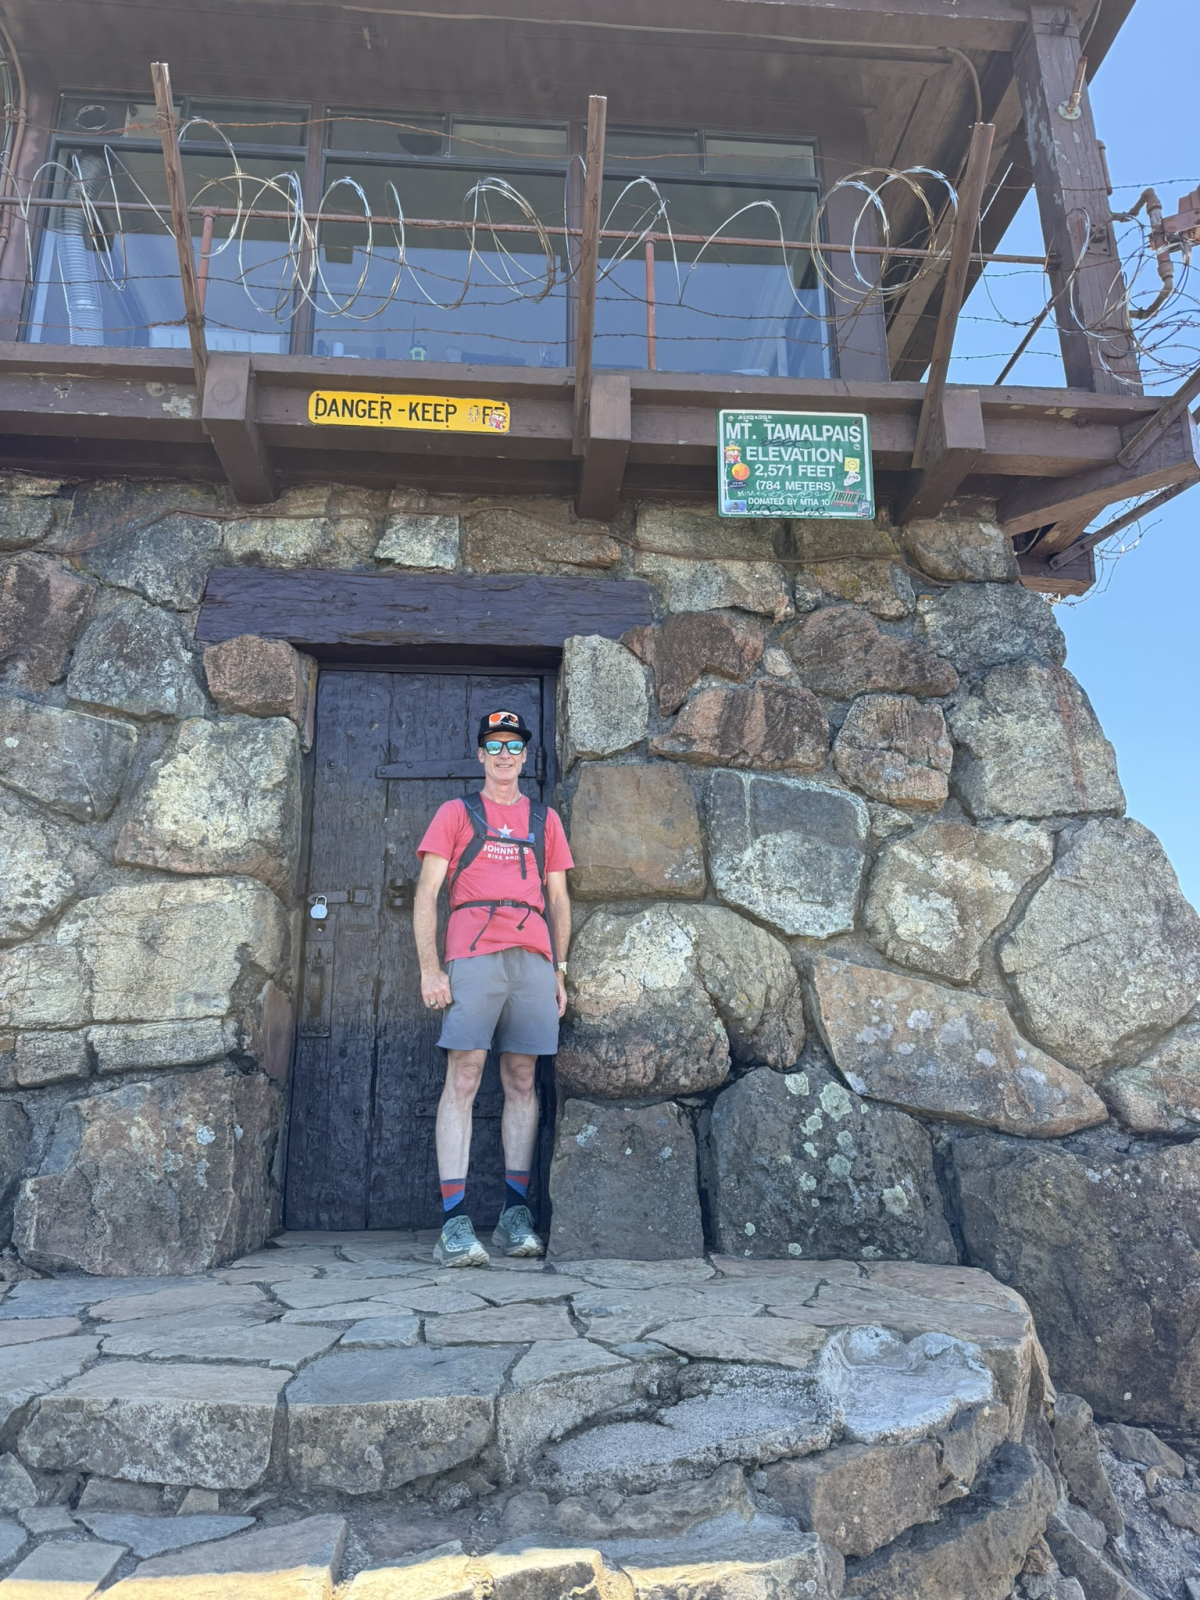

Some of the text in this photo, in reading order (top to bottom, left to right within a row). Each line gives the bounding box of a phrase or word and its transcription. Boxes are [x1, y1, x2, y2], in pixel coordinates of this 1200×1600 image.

[315, 398, 392, 420] DANGER
[409, 402, 457, 423] KEEP
[726, 423, 861, 442] MT. TAMALPAIS
[746, 446, 843, 463] ELEVATION
[755, 464, 835, 478] 2,571 FEET
[756, 481, 780, 491] (784
[786, 481, 835, 491] METERS)
[748, 497, 784, 505] DONATED
[483, 844, 529, 855] JOHNNYS
